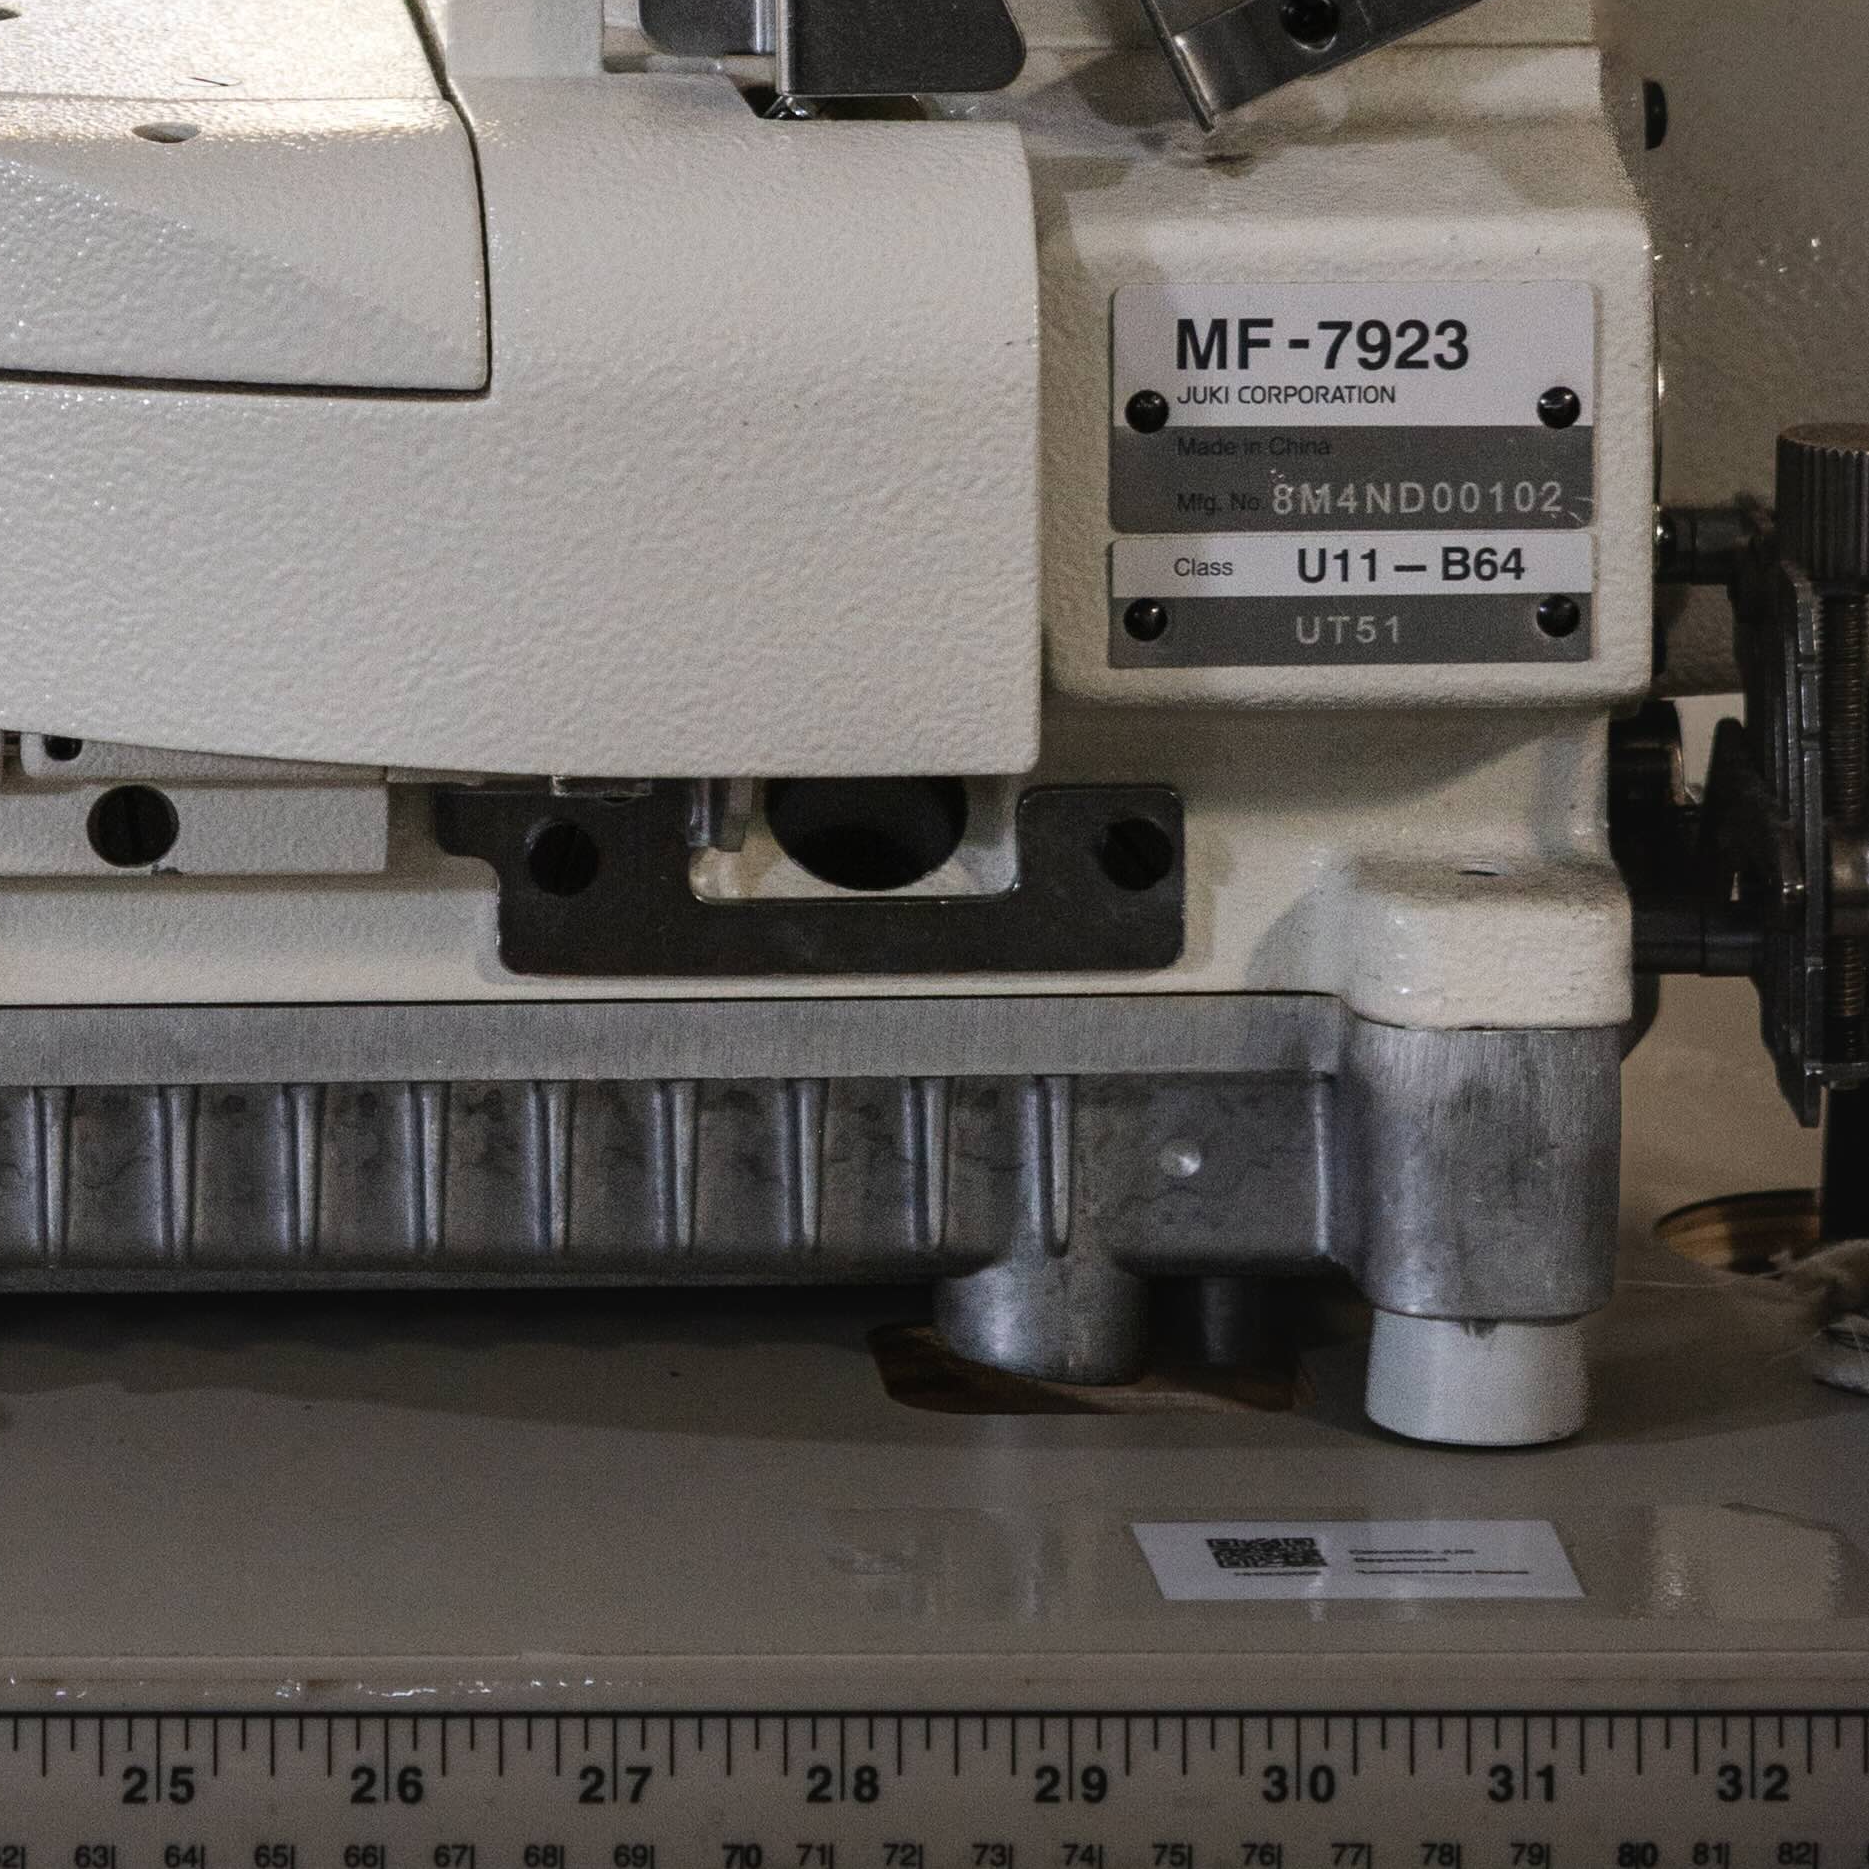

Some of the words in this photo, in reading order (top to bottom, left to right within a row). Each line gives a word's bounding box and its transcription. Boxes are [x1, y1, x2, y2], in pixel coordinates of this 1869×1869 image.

[1176, 318, 1470, 370] MF-7923
[1177, 385, 1230, 405] JUKI
[1238, 385, 1396, 405] CORPORATION
[1177, 437, 1236, 456] Made
[1244, 437, 1261, 456] in
[1268, 436, 1332, 456] China
[1272, 480, 1563, 516] 8M4ND00102
[1174, 557, 1234, 577] Class
[1295, 616, 1403, 645] UT51
[123, 1766, 194, 1804] 25
[351, 1766, 423, 1804] 26
[579, 1766, 652, 1804] 27
[807, 1765, 879, 1803] 28
[1035, 1765, 1107, 1803] 29
[1263, 1765, 1335, 1803] 30
[1488, 1764, 1555, 1803] 31
[1718, 1764, 1789, 1802] 32
[74, 1846, 109, 1869] 63
[164, 1845, 198, 1868] 64
[254, 1845, 289, 1869] 65
[344, 1845, 378, 1868] 66
[433, 1844, 469, 1868] 67
[524, 1846, 558, 1868] 68
[614, 1845, 648, 1868] 69
[797, 1843, 830, 1866] 71
[884, 1843, 918, 1867] 72
[973, 1843, 1008, 1867] 73
[1064, 1843, 1097, 1866] 74
[1153, 1843, 1188, 1867] 75
[1243, 1843, 1278, 1866] 76
[1332, 1842, 1368, 1866] 77
[1423, 1843, 1457, 1866] 78
[1512, 1842, 1546, 1866] 79
[1693, 1843, 1723, 1866] 81
[1778, 1842, 1812, 1865] 82
